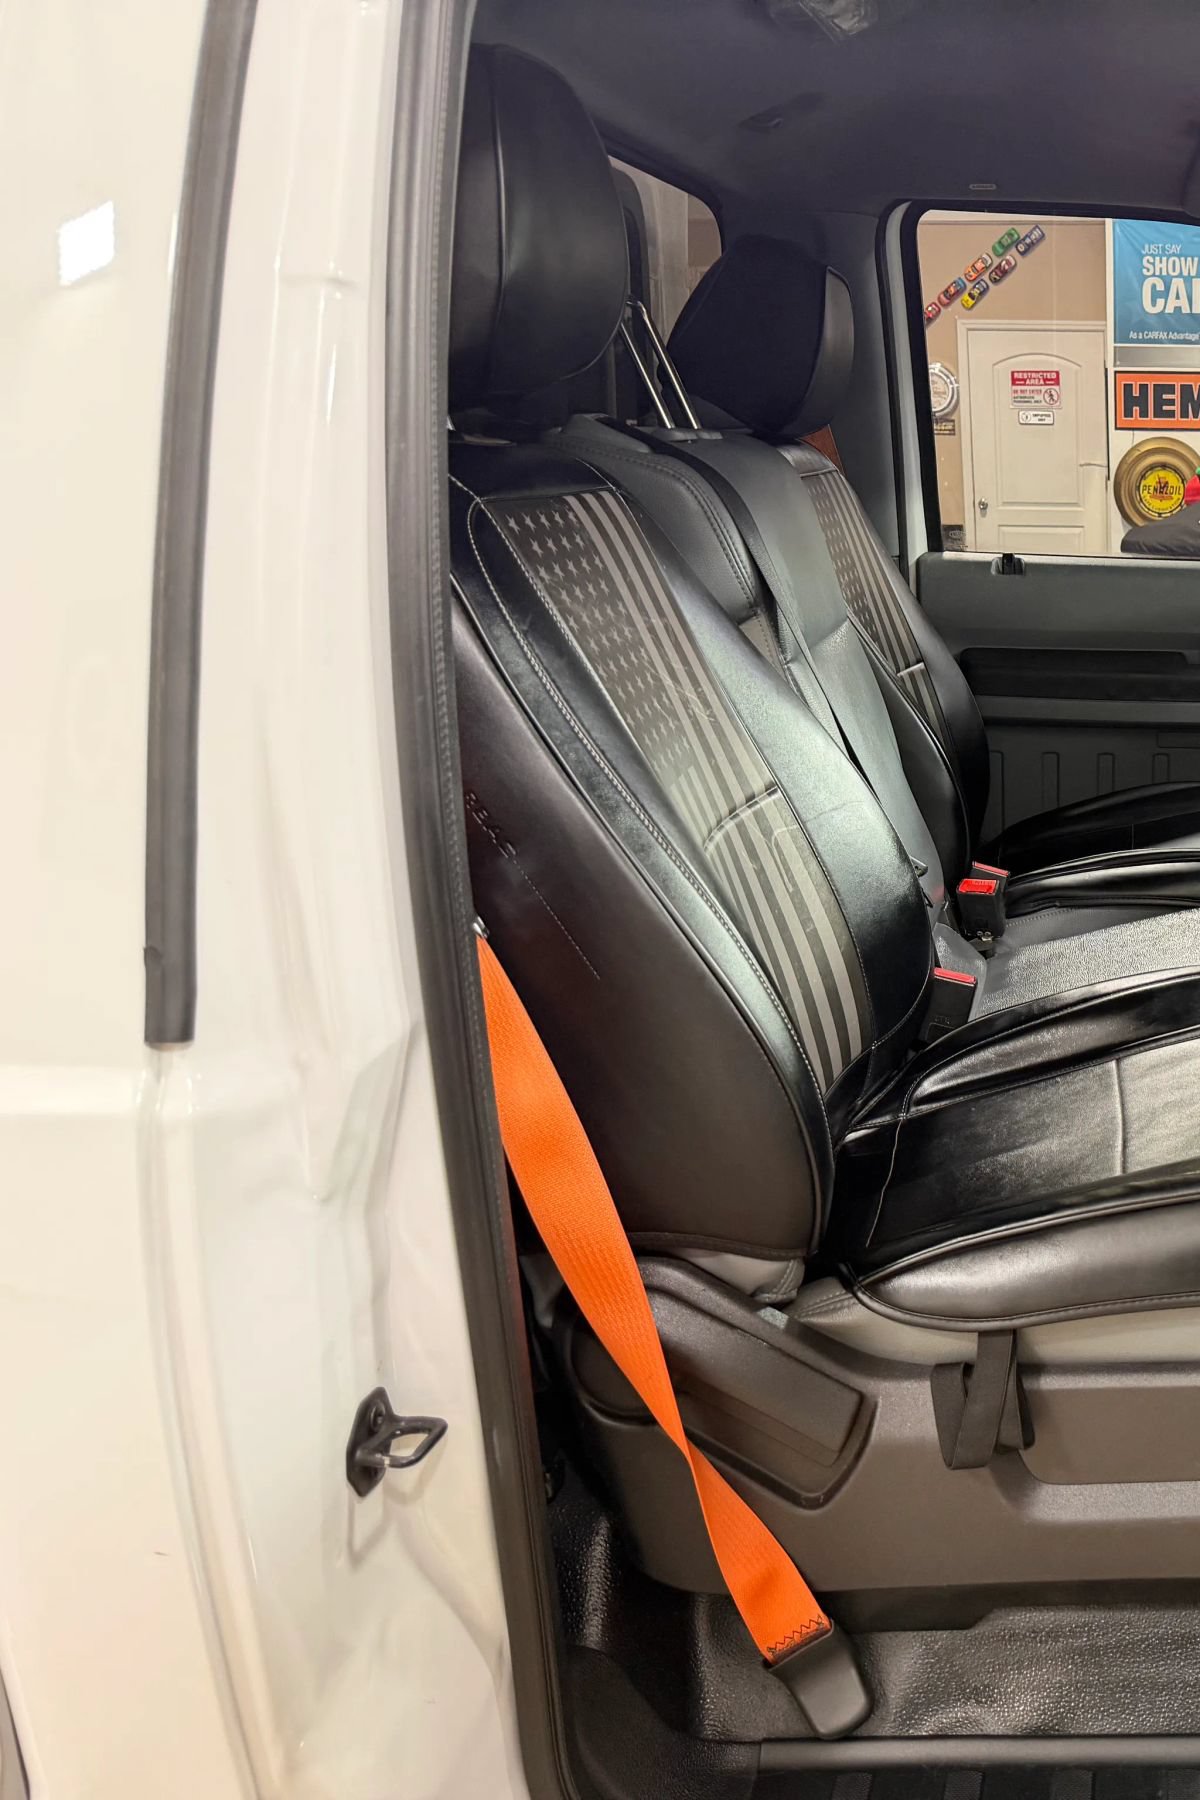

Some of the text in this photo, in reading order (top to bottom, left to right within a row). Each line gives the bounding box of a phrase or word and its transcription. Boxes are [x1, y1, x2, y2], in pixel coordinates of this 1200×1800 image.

[1141, 244, 1181, 254] JUST SAY
[1142, 257, 1198, 277] SHOW
[1129, 331, 1137, 339] As
[1143, 331, 1167, 340] CARFAX
